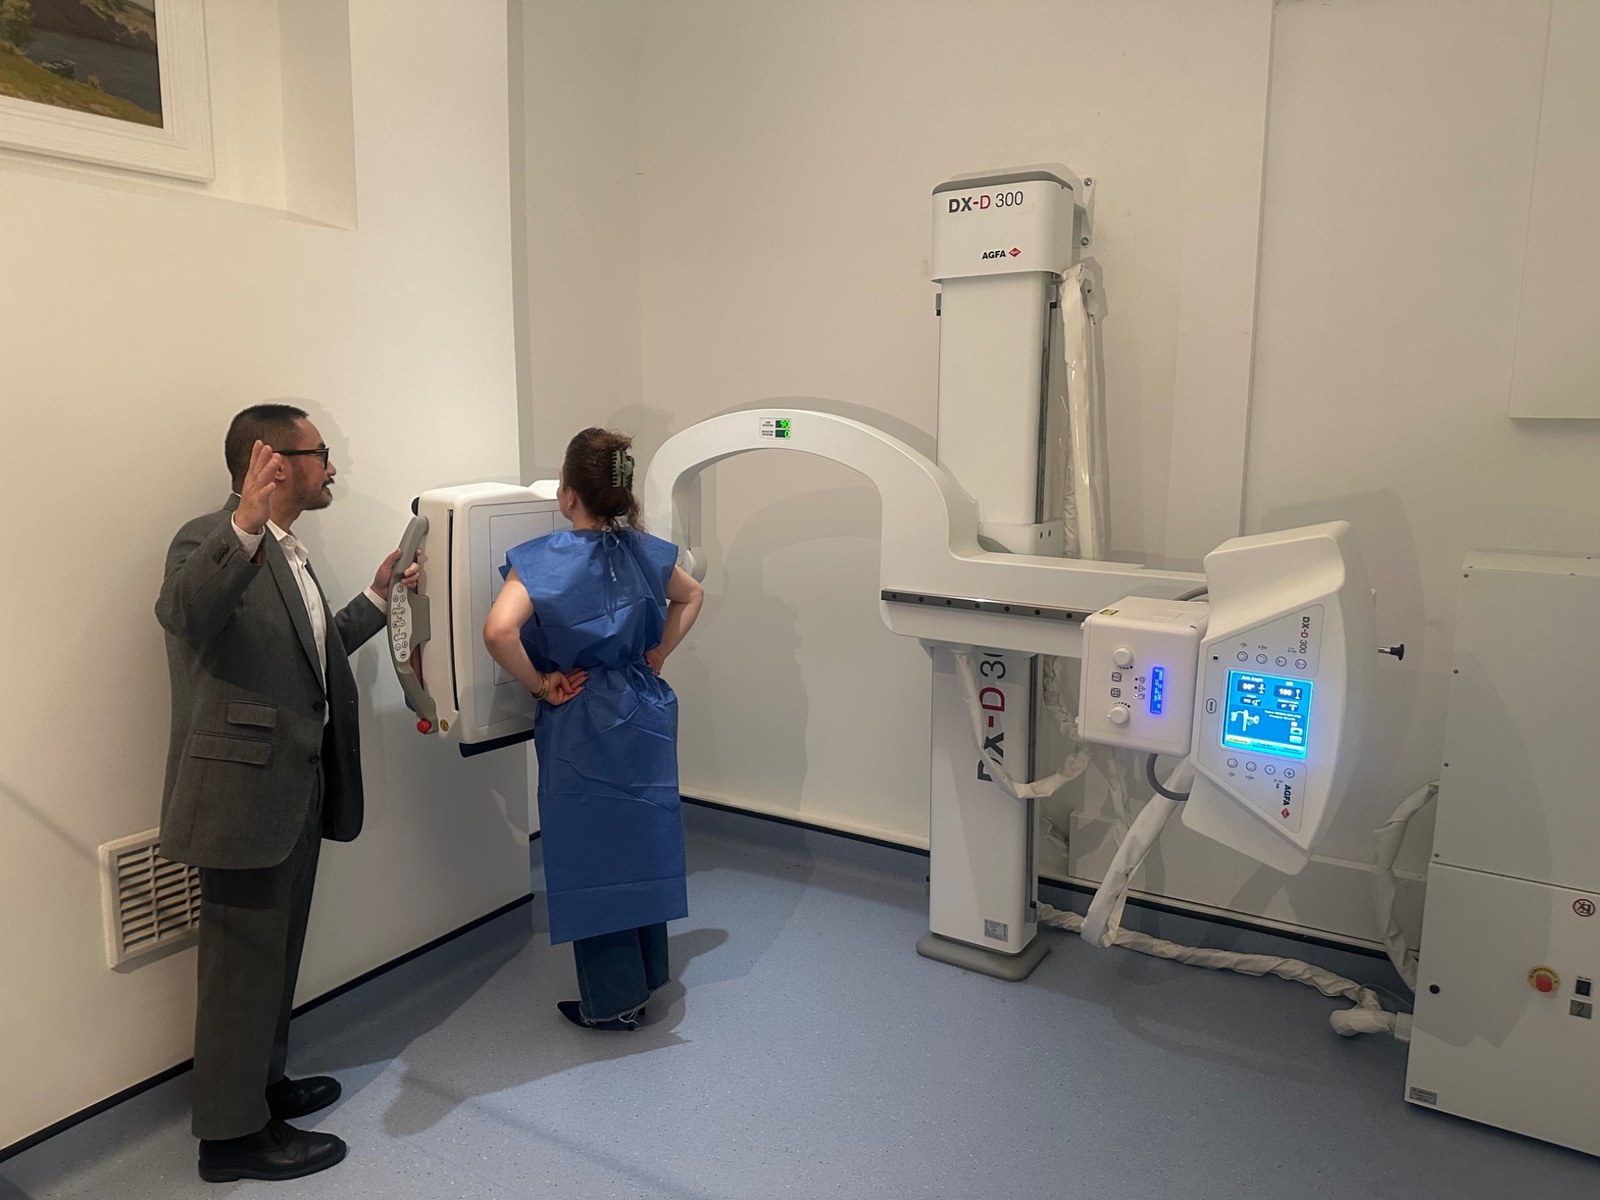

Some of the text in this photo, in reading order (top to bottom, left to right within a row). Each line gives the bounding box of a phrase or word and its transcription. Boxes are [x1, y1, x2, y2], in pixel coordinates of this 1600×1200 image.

[948, 190, 1024, 213] DX-D 300
[981, 250, 1006, 260] AGFA
[1299, 616, 1310, 654] DX-D 300
[1283, 784, 1292, 806] AGFA
